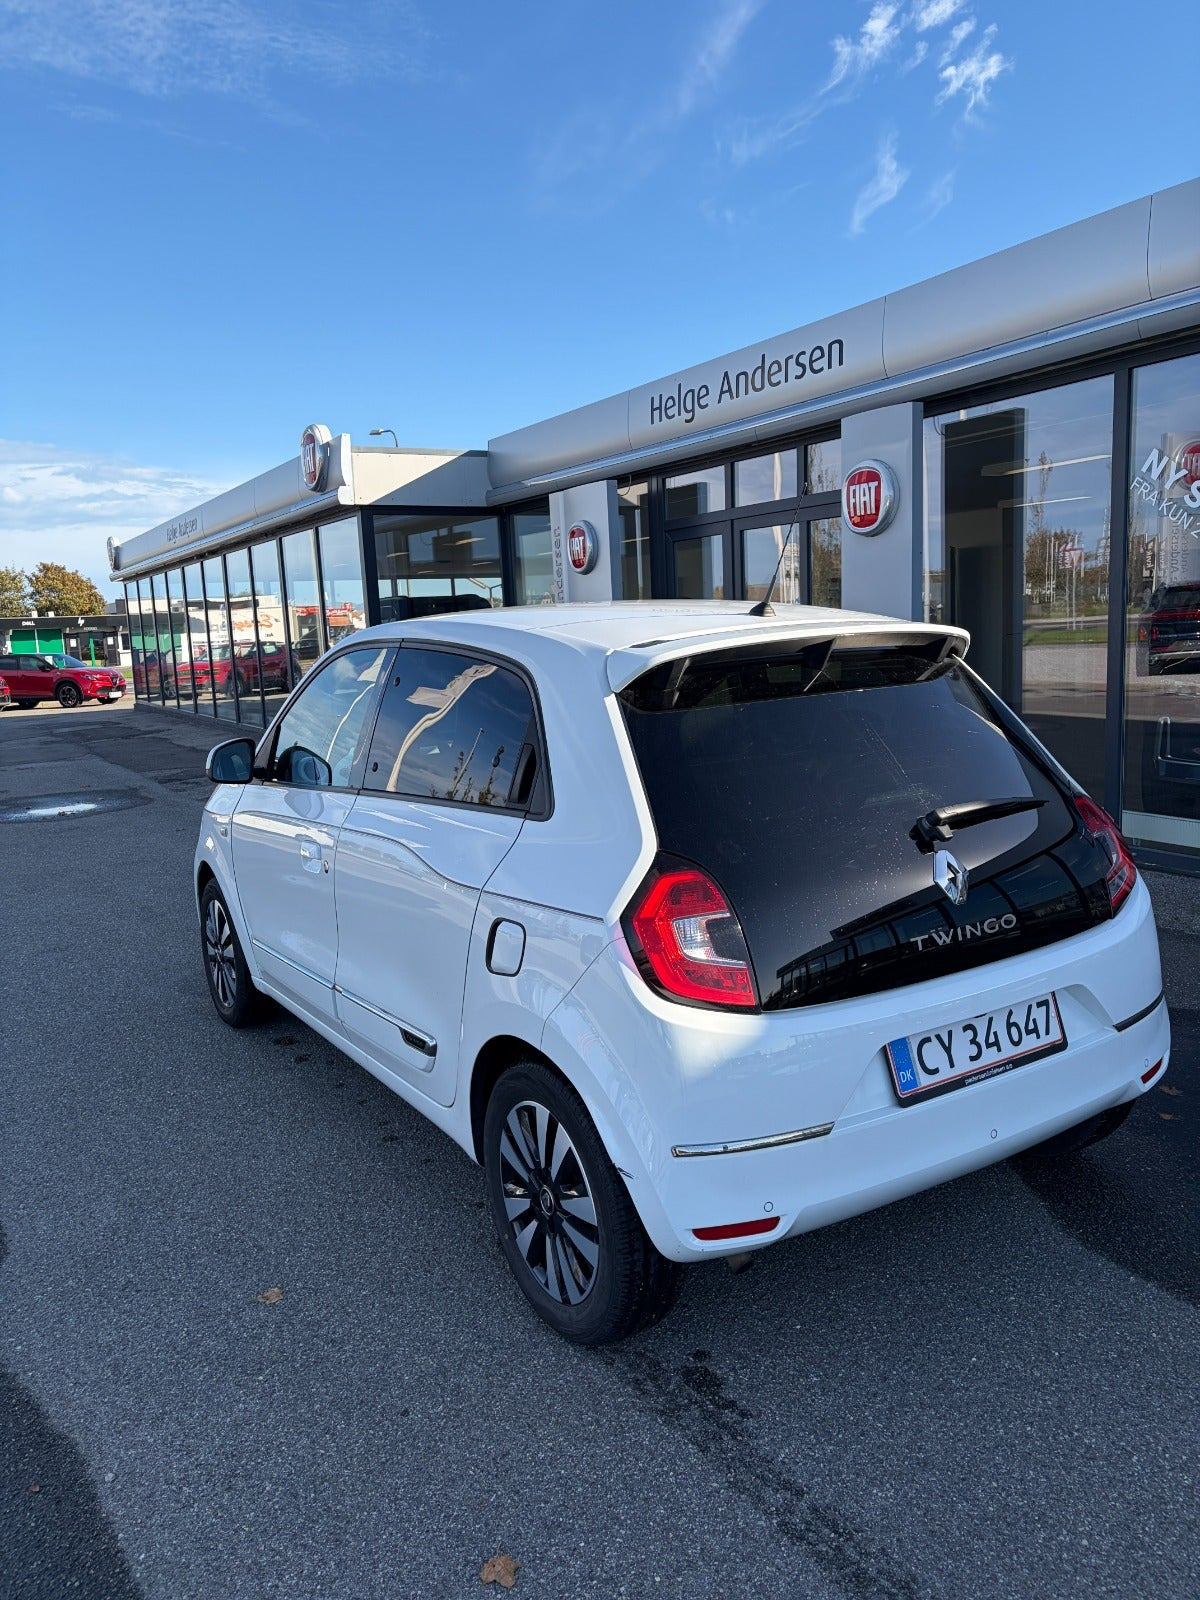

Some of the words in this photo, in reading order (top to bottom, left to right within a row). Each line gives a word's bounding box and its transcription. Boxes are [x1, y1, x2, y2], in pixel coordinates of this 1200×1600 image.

[650, 382, 710, 424] Helge
[717, 338, 844, 404] Andersen
[1141, 447, 1188, 490] NY
[849, 481, 878, 517] FIAT
[1130, 476, 1158, 506] FRA
[1159, 498, 1193, 529] KUN
[553, 526, 564, 603] ndersen
[910, 913, 1017, 951] TWINGO
[916, 1029, 955, 1076] CY
[962, 1016, 1002, 1062] 34
[1005, 998, 1050, 1047] 647
[900, 1068, 914, 1083] DK
